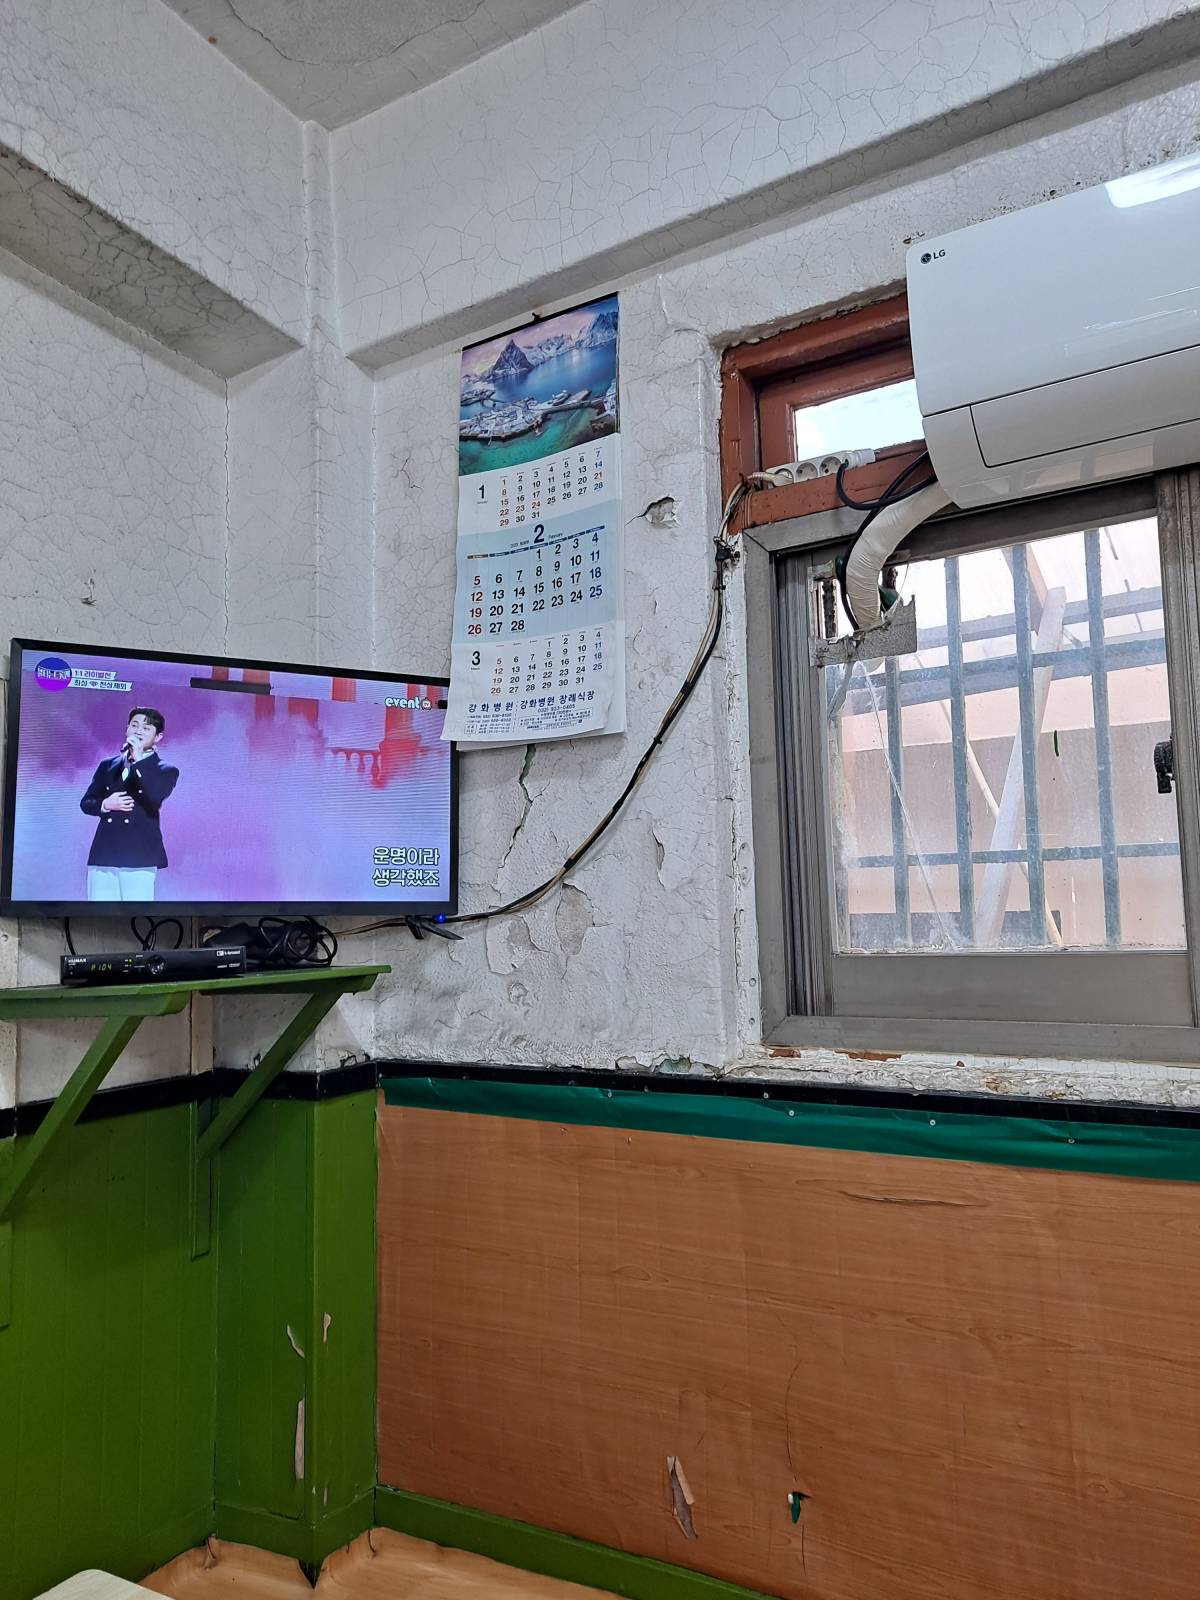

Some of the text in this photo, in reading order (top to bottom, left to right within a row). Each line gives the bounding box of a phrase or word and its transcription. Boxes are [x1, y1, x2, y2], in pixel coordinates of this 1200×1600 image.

[933, 249, 946, 260] LG
[479, 485, 485, 499] 1
[578, 487, 587, 495] 27
[594, 482, 603, 490] 28
[534, 524, 544, 543] 2
[536, 550, 541, 559] 1
[554, 544, 561, 554] 2
[572, 538, 579, 548] 3
[591, 532, 599, 542] 4
[474, 550, 600, 585] 5 6 7 8 9 10 11
[471, 567, 602, 600] 12 13 14 15 16 17 18
[470, 586, 603, 618] 19 20 21 22 23 24 25
[468, 620, 524, 634] 26 27 28
[472, 651, 480, 666] 3
[385, 697, 420, 709] event
[520, 691, 595, 710] 강화병원 장례식장
[374, 846, 440, 865] 운명이라
[373, 869, 439, 886] 생각했죠
